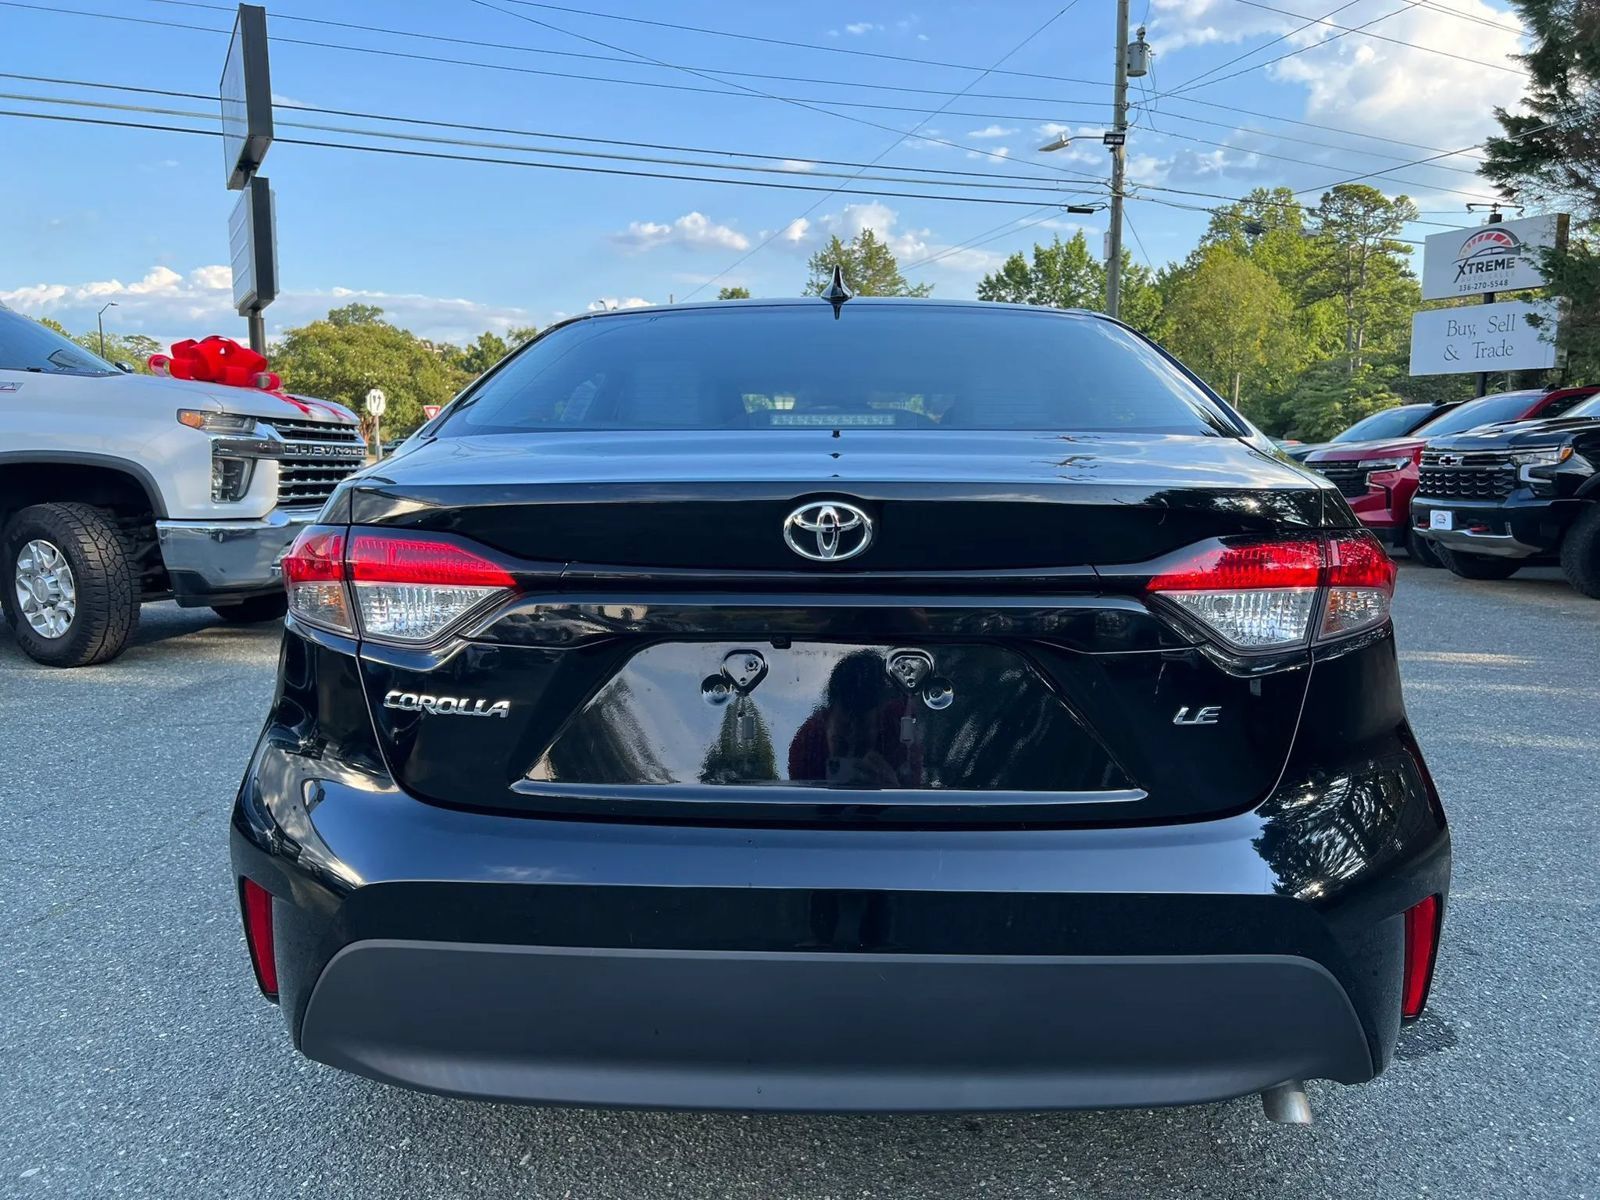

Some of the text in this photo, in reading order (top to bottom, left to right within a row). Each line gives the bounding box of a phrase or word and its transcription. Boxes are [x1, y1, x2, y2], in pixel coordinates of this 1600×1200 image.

[1454, 257, 1515, 283] XTREME
[1447, 313, 1516, 338] Buy, Sell
[1443, 339, 1514, 361] & Trade
[284, 444, 367, 457] CHEVROLET
[383, 690, 511, 718] COROLLA
[1173, 706, 1222, 725] LE
